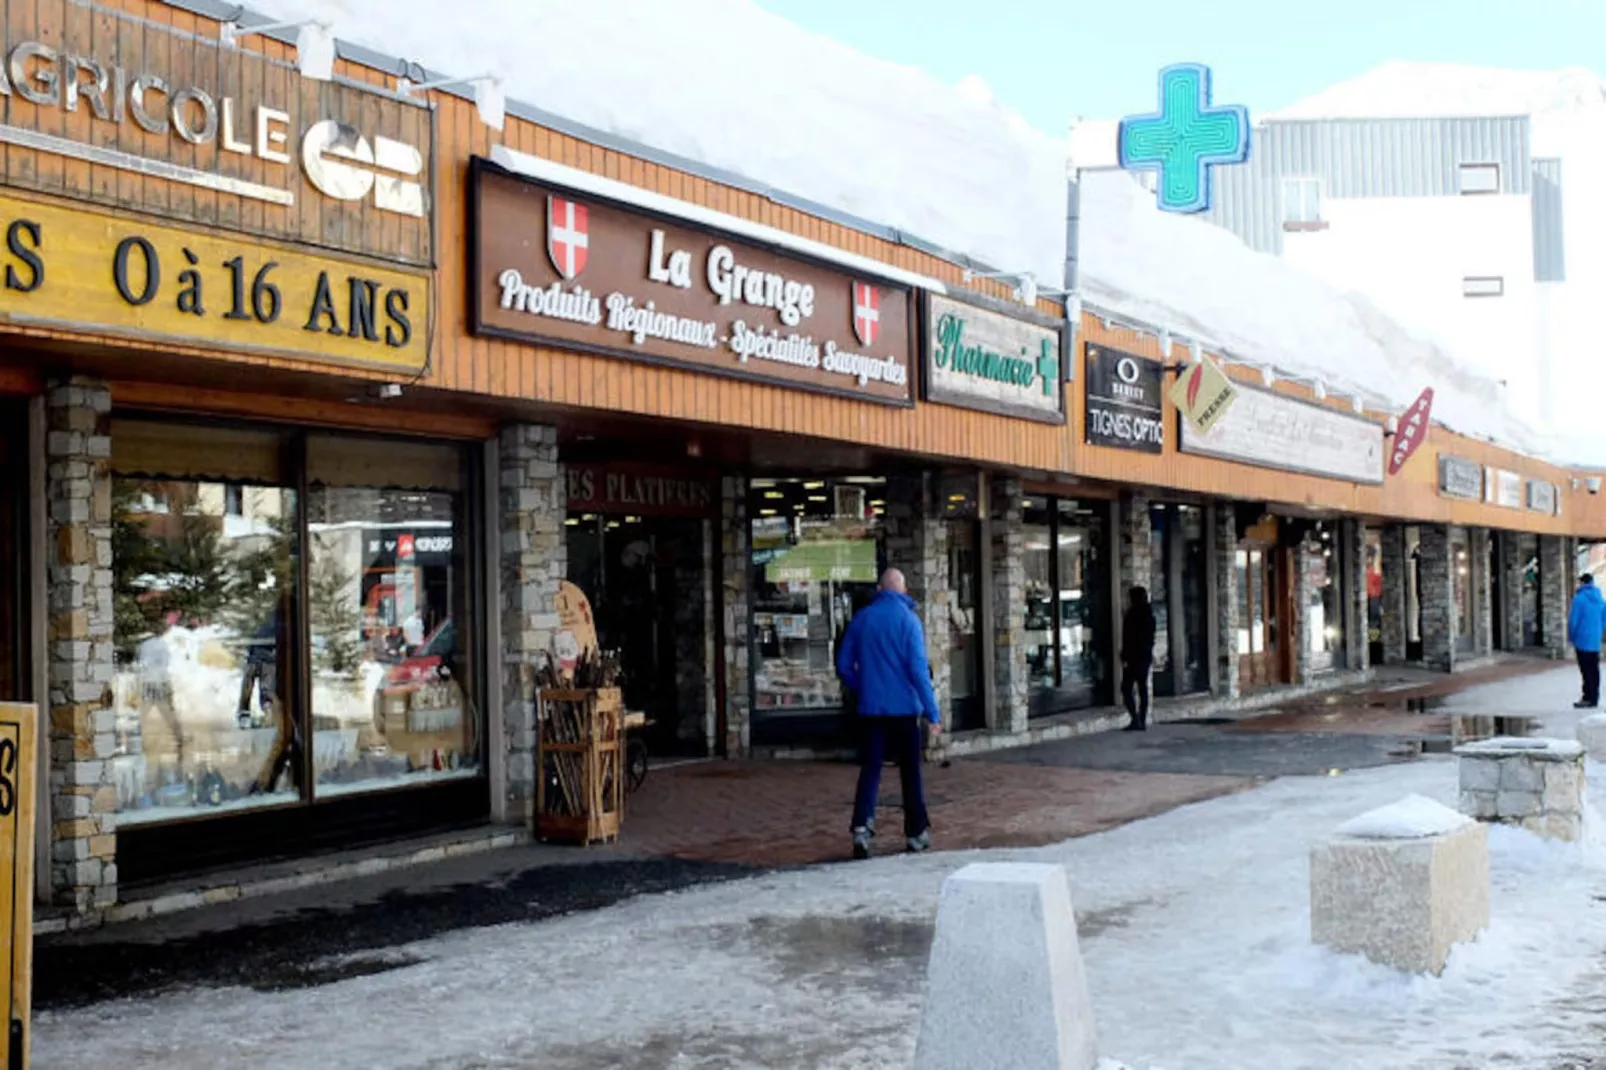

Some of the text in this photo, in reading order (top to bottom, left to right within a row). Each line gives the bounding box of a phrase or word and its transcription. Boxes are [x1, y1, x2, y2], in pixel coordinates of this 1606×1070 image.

[6, 219, 44, 292] S
[176, 247, 204, 317] à
[223, 256, 282, 323] 16
[303, 271, 412, 348] ANS
[650, 229, 815, 327] La Grange
[499, 269, 601, 325] Produits
[606, 291, 717, 348] Régionaux
[731, 320, 820, 363] Spécialités
[823, 340, 907, 387] Savoyardes
[935, 313, 1034, 388] Pharmacie
[1090, 408, 1132, 440] TIGNES
